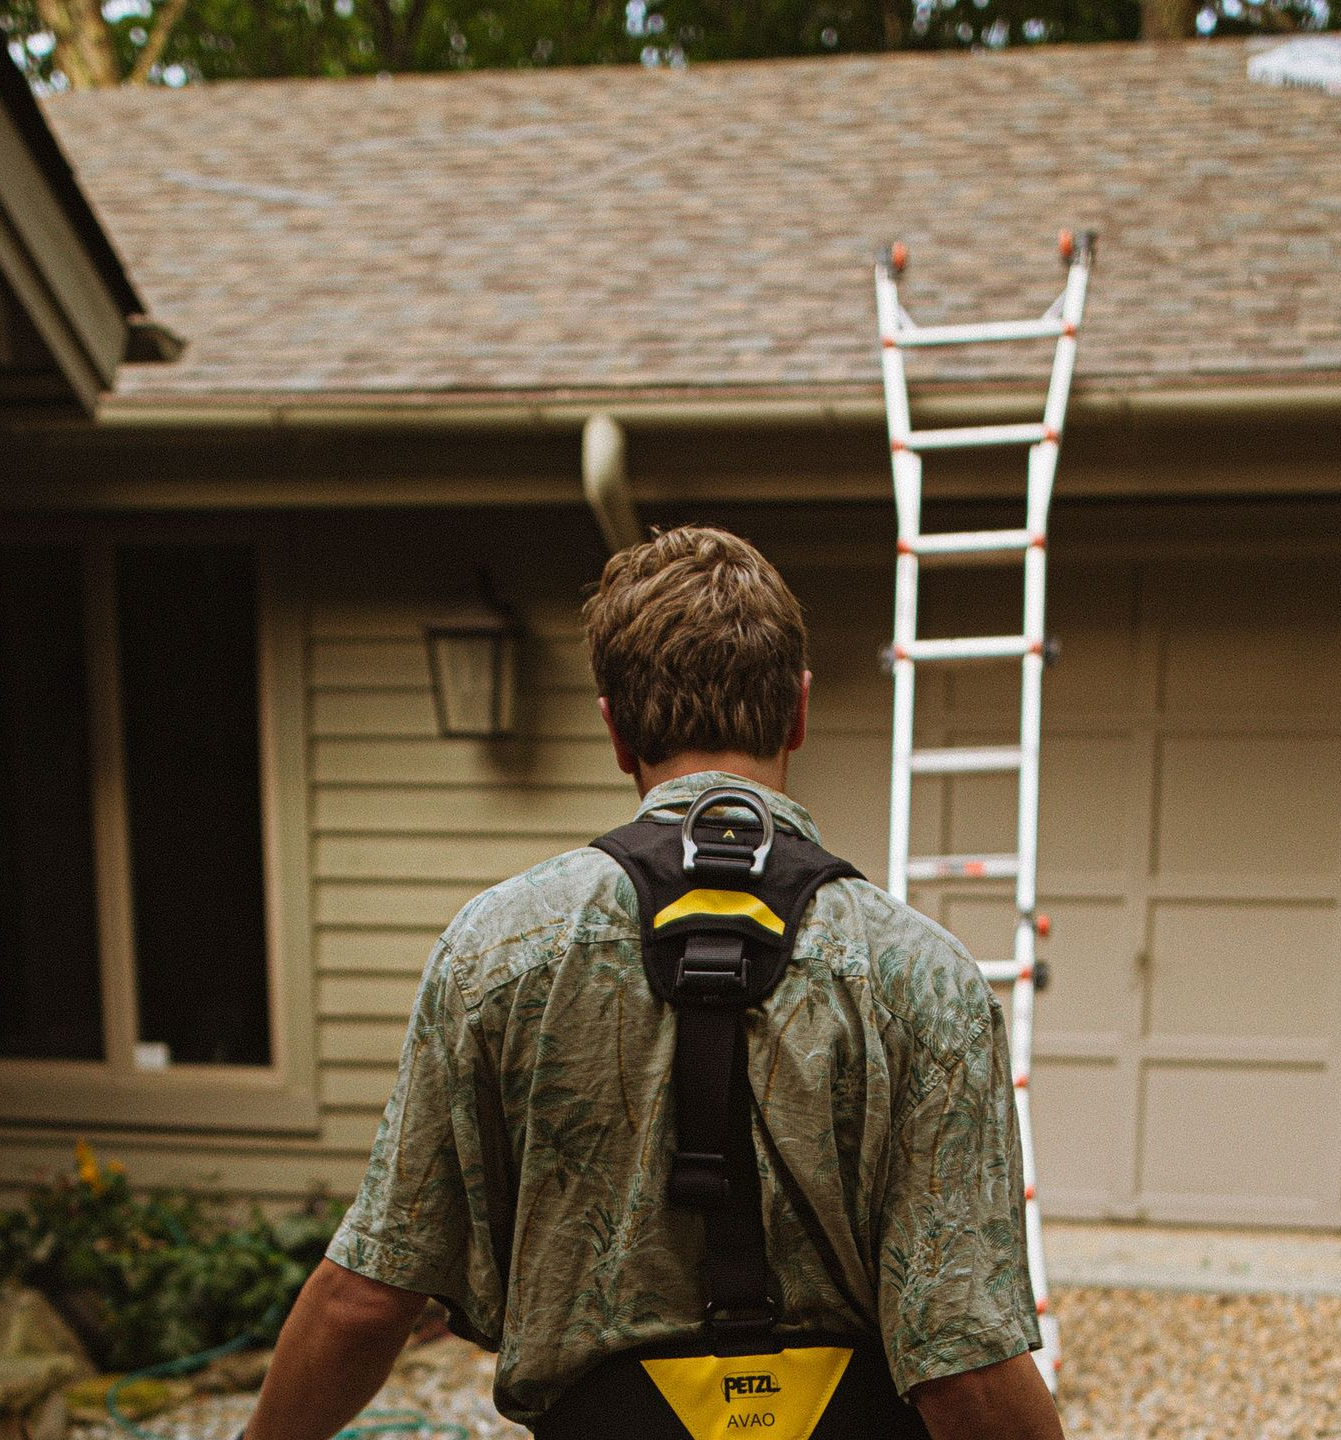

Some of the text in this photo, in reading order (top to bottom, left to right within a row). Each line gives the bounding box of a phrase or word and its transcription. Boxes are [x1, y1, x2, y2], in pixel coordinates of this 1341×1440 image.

[723, 829, 735, 839] A
[724, 1375, 781, 1403] PETZL
[727, 1412, 775, 1428] AVAO
